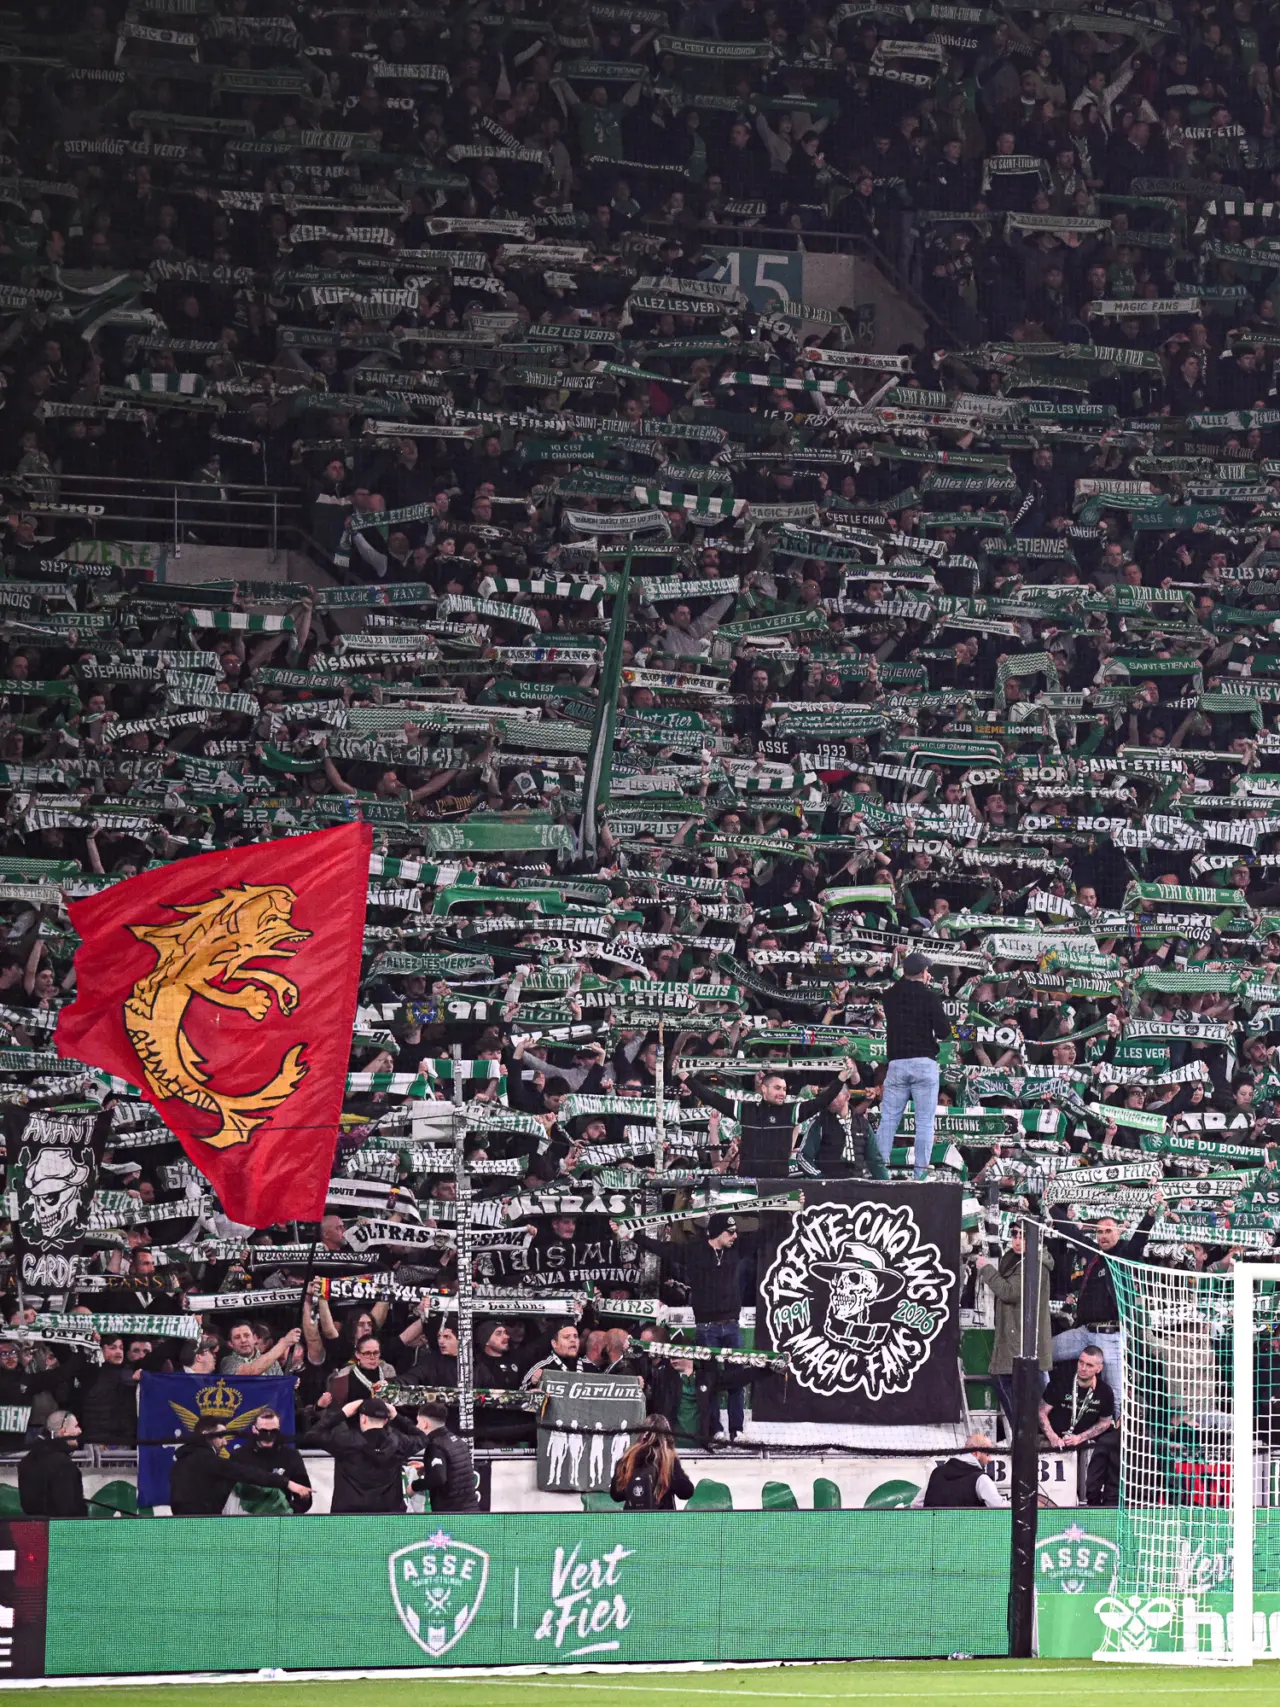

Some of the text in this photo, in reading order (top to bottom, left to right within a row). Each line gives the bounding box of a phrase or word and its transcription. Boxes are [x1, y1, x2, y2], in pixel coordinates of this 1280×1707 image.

[1114, 300, 1179, 312] MAGIC FANS
[529, 325, 616, 342] ALLEZ LES VERTS
[1029, 404, 1103, 415] ALLEZ LES VERTS
[933, 477, 1016, 489] Allez les Verts
[765, 614, 801, 628] VERTS
[889, 693, 920, 707] Allez
[921, 694, 941, 706] les
[1254, 685, 1272, 700] LES
[1007, 725, 1043, 735] HOMME
[758, 740, 847, 758] ASSE 1933
[1158, 884, 1217, 901] VERT & FIER
[385, 955, 477, 969] ALLEZ LES VERTS
[629, 979, 730, 997] ALLEZ LES VERTS
[448, 1002, 488, 1021] 91
[21, 1112, 99, 1146] AVANT
[1169, 1137, 1215, 1151] QUE DU
[353, 1219, 430, 1244] ULTRAS
[22, 1253, 79, 1289] GARDE
[902, 1255, 939, 1301] ANS
[213, 1296, 238, 1309] Les
[773, 1299, 811, 1333] 1991
[893, 1301, 935, 1334] 2026
[782, 1325, 922, 1391] MAGIC FANS
[402, 1555, 477, 1581] ASSE
[549, 1541, 637, 1600] Vert
[1040, 1551, 1106, 1572] ASSE
